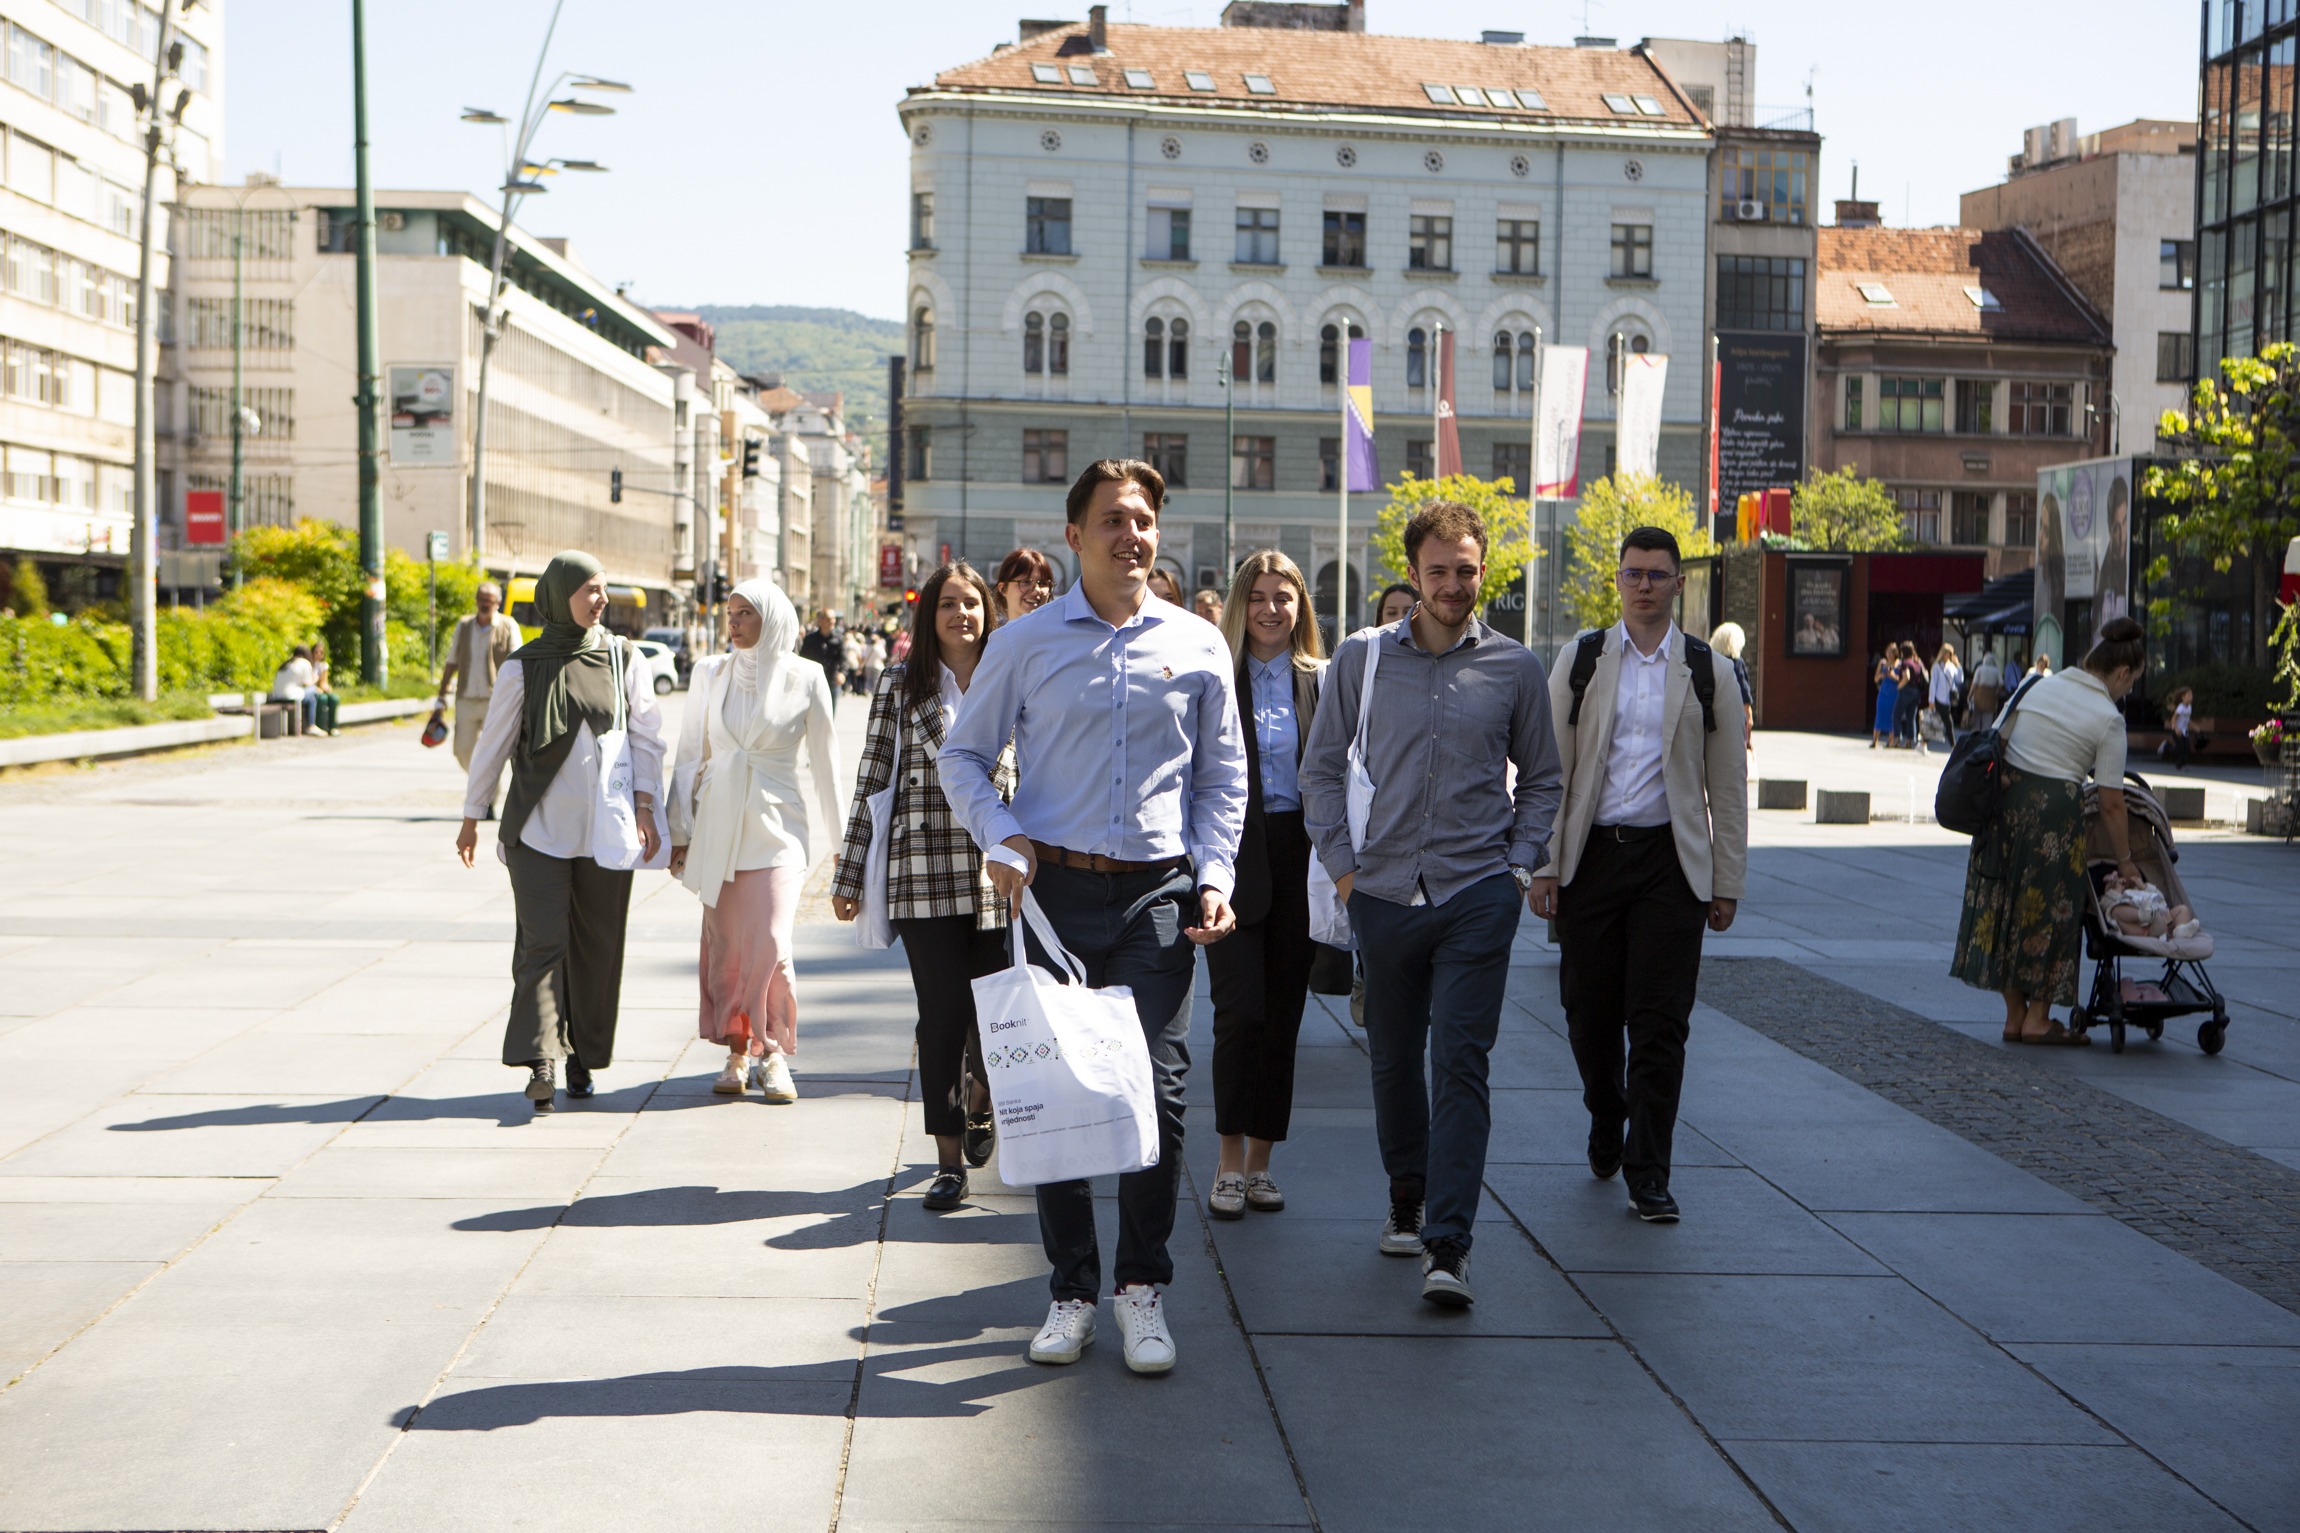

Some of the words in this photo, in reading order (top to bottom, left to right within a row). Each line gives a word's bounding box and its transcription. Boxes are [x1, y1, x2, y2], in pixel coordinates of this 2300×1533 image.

[990, 1018, 1027, 1033] Booknit
[1008, 1106, 1024, 1115] koja
[1024, 1102, 1044, 1113] spaja
[1001, 1113, 1036, 1127] vrijednosti
